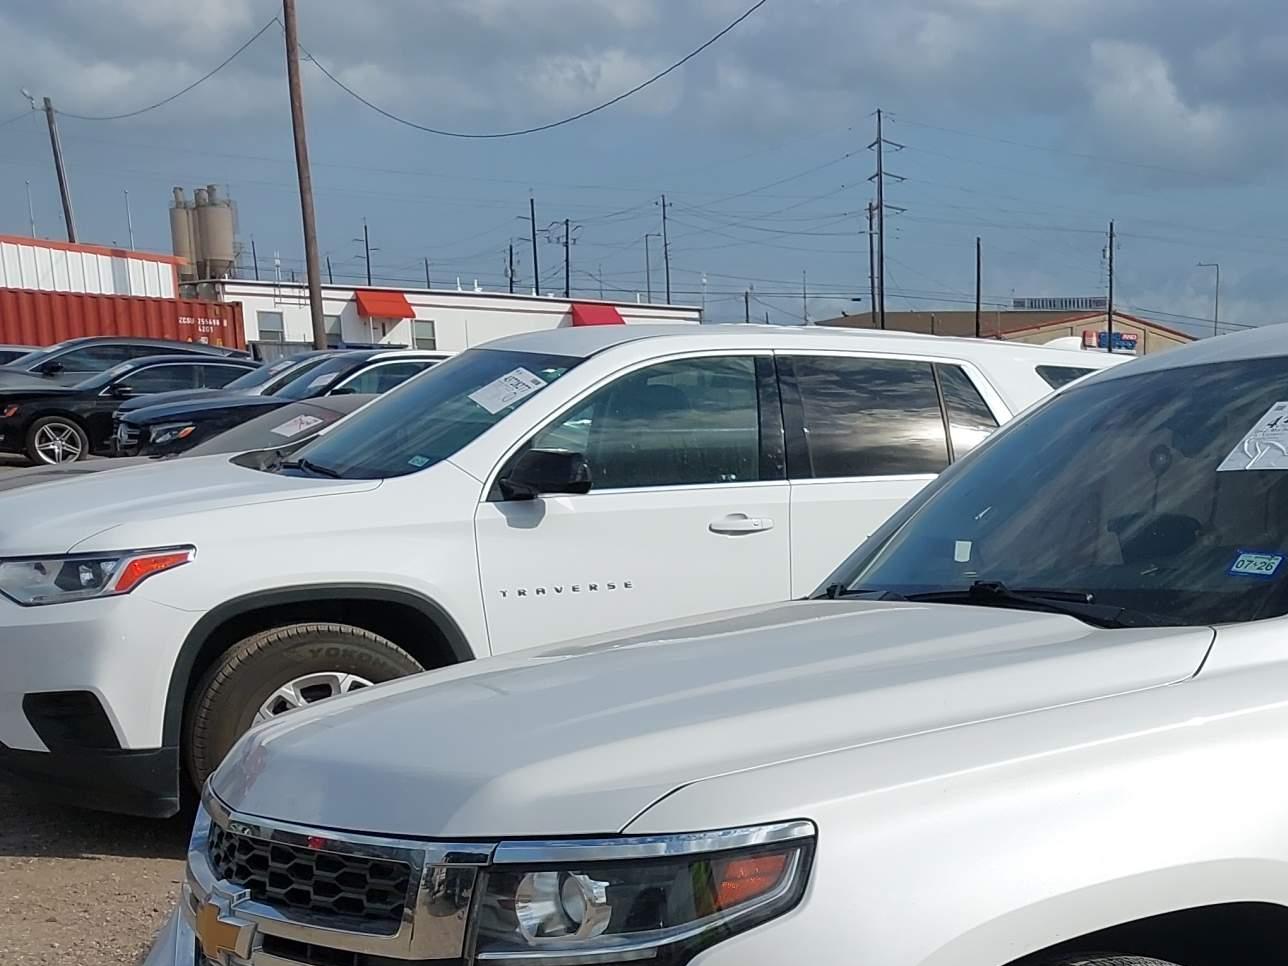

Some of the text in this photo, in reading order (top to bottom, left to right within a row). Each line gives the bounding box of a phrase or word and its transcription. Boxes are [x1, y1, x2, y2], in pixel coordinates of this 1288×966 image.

[1235, 559, 1276, 571] 07 26
[499, 581, 633, 598] TRAVERSE
